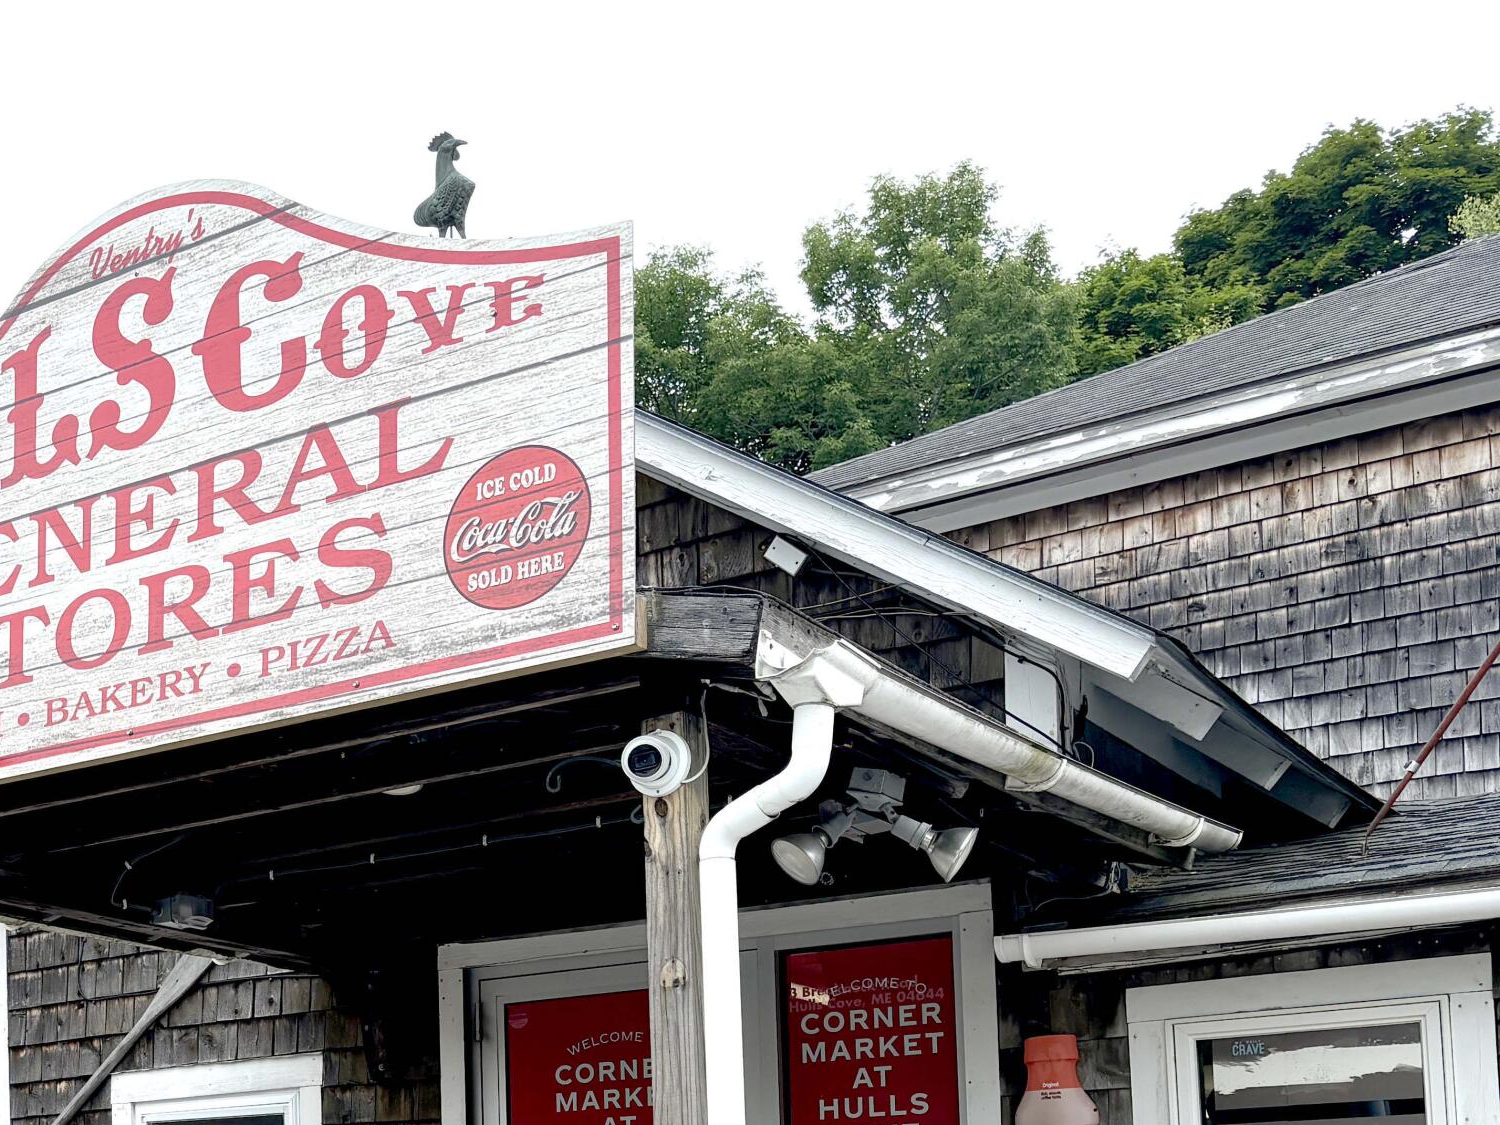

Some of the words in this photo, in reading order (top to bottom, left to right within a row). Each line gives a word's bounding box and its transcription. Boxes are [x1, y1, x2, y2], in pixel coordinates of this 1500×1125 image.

[88, 208, 205, 279] Ventry's
[191, 252, 548, 412] COVE
[476, 476, 506, 501] ICE
[509, 462, 557, 492] COLD
[450, 488, 583, 564] Coca-Cola
[467, 565, 513, 592] SOLD
[517, 551, 565, 581] HERE
[44, 662, 212, 727] BAKERY
[259, 619, 396, 677] PIZZA
[800, 1002, 943, 1035] CORNER
[566, 1031, 644, 1056] WELCOME
[801, 1031, 944, 1064] MARKET
[1232, 1043, 1265, 1056] CRAVE
[555, 1058, 652, 1085] CORNE
[852, 1065, 893, 1089] AT
[818, 1092, 930, 1121] HULLS
